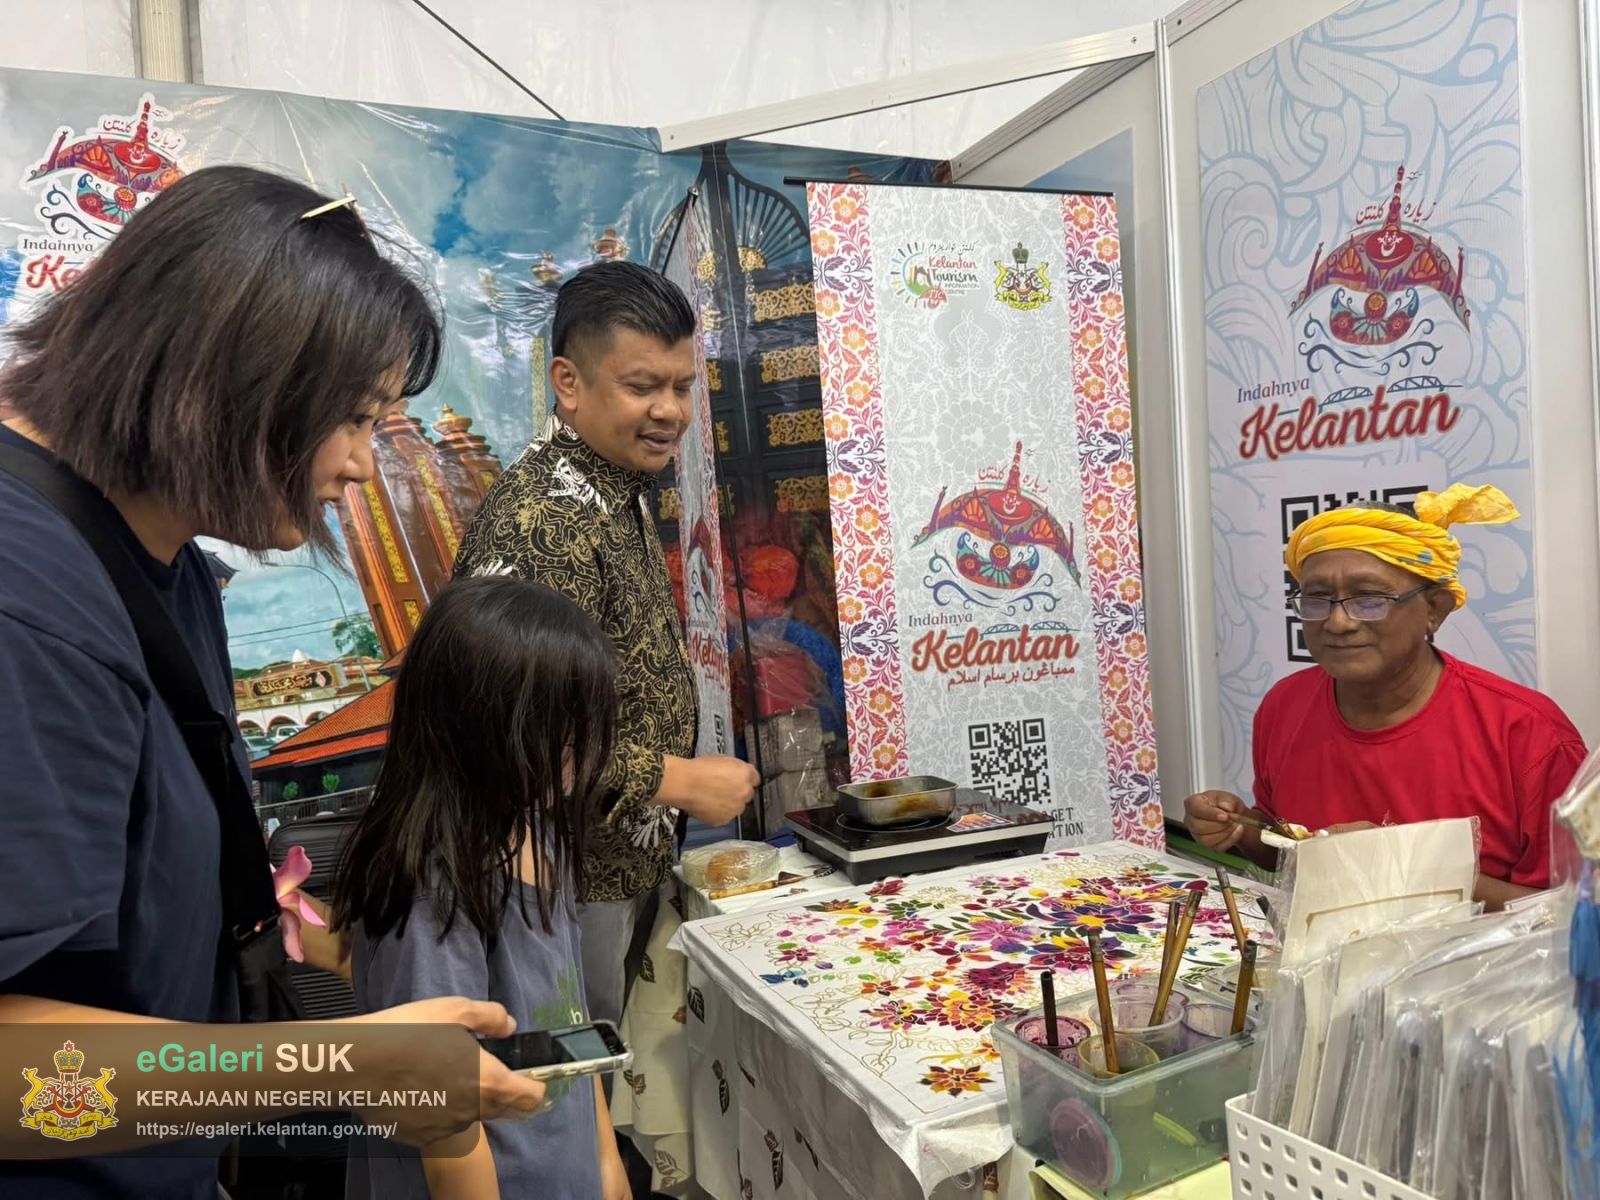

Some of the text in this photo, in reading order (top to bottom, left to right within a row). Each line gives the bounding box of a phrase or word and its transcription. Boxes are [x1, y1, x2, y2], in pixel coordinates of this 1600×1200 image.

[23, 238, 94, 254] Indahnya
[928, 256, 977, 269] Kelantan
[931, 268, 978, 282] Tourism
[1237, 377, 1310, 404] Indahnya
[1239, 384, 1460, 460] Kelantan
[908, 612, 973, 628] Indahnya
[911, 624, 1081, 674] Kelantan
